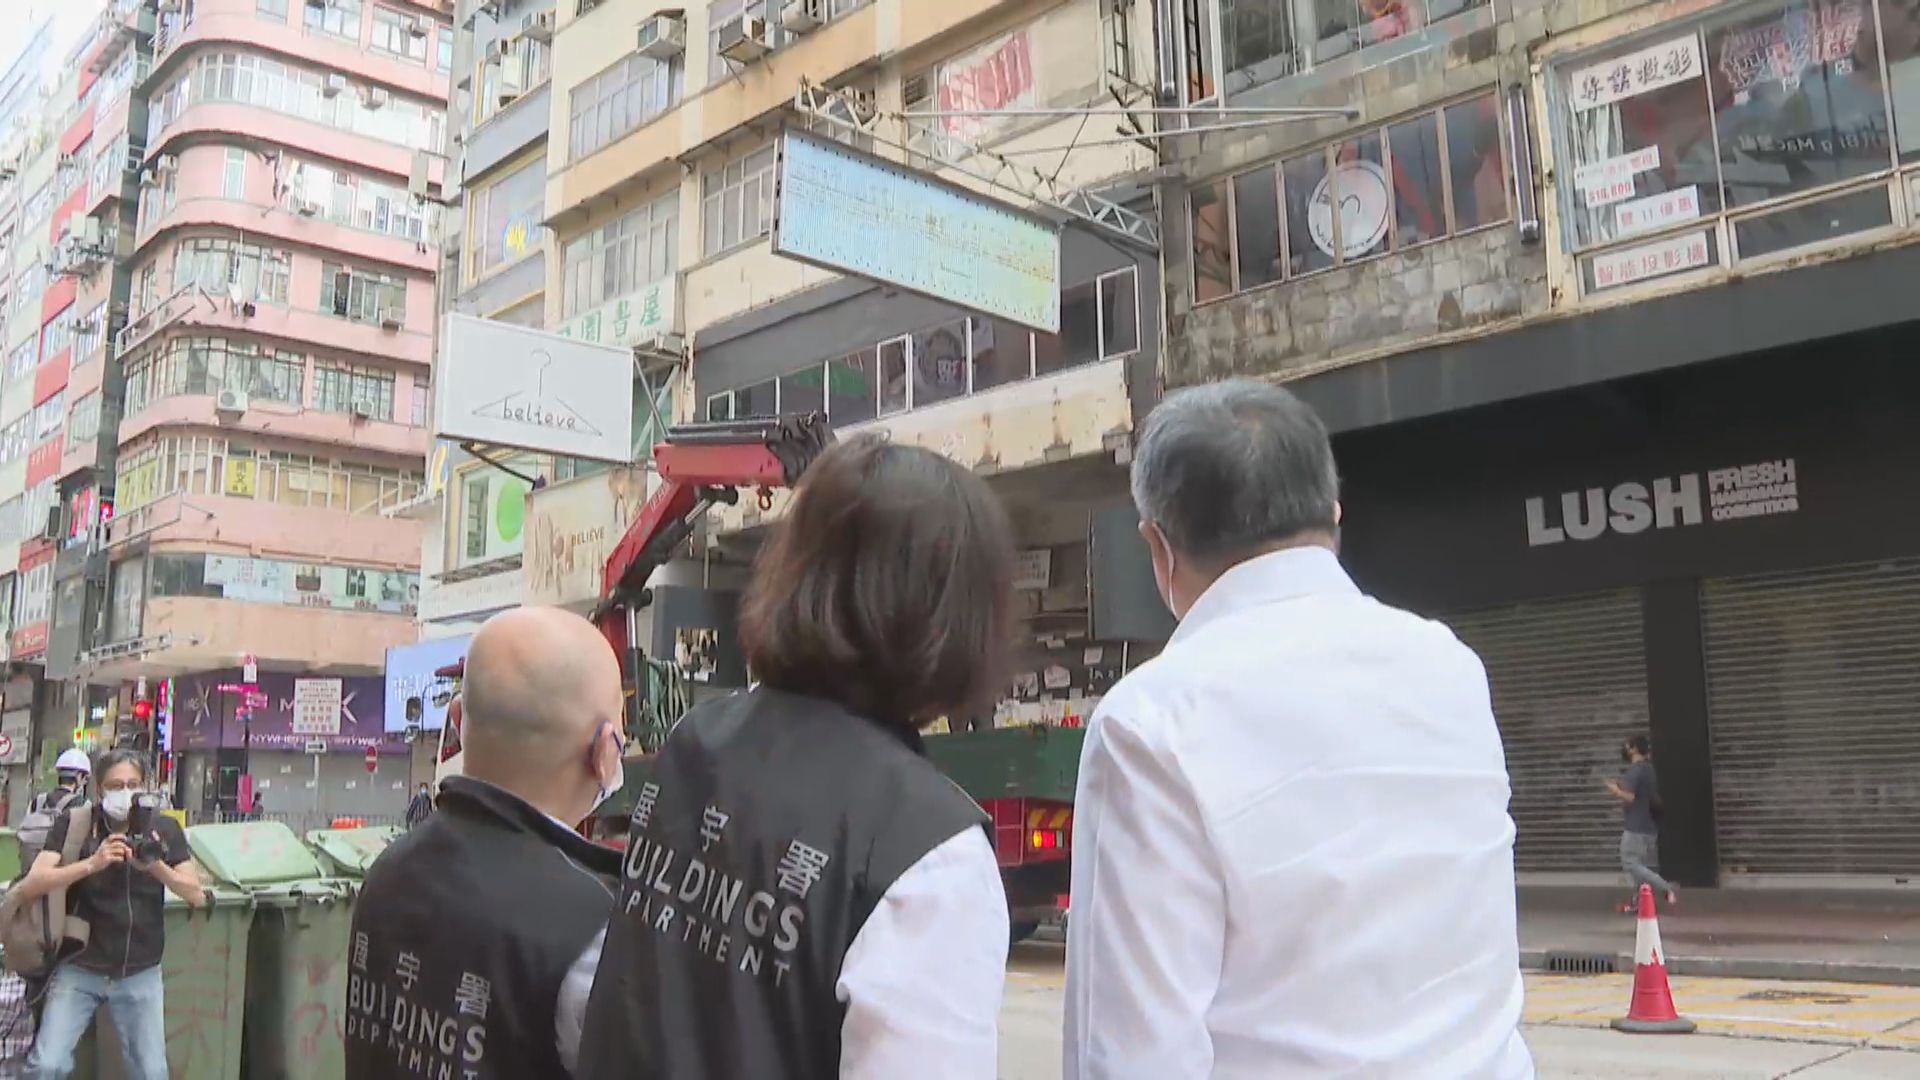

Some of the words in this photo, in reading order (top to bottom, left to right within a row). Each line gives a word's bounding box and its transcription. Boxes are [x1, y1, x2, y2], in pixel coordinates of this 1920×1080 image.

[503, 398, 577, 430] believe
[571, 526, 605, 546] BELIEVE
[1525, 472, 1702, 547] LUSH
[1708, 457, 1796, 492] FRESH
[632, 781, 830, 900] 屋宇署
[624, 884, 791, 988] PARTMENT
[625, 835, 805, 952] UILDINGS
[349, 974, 487, 1063] BUIDINGS
[352, 931, 492, 1020] 屋宇署
